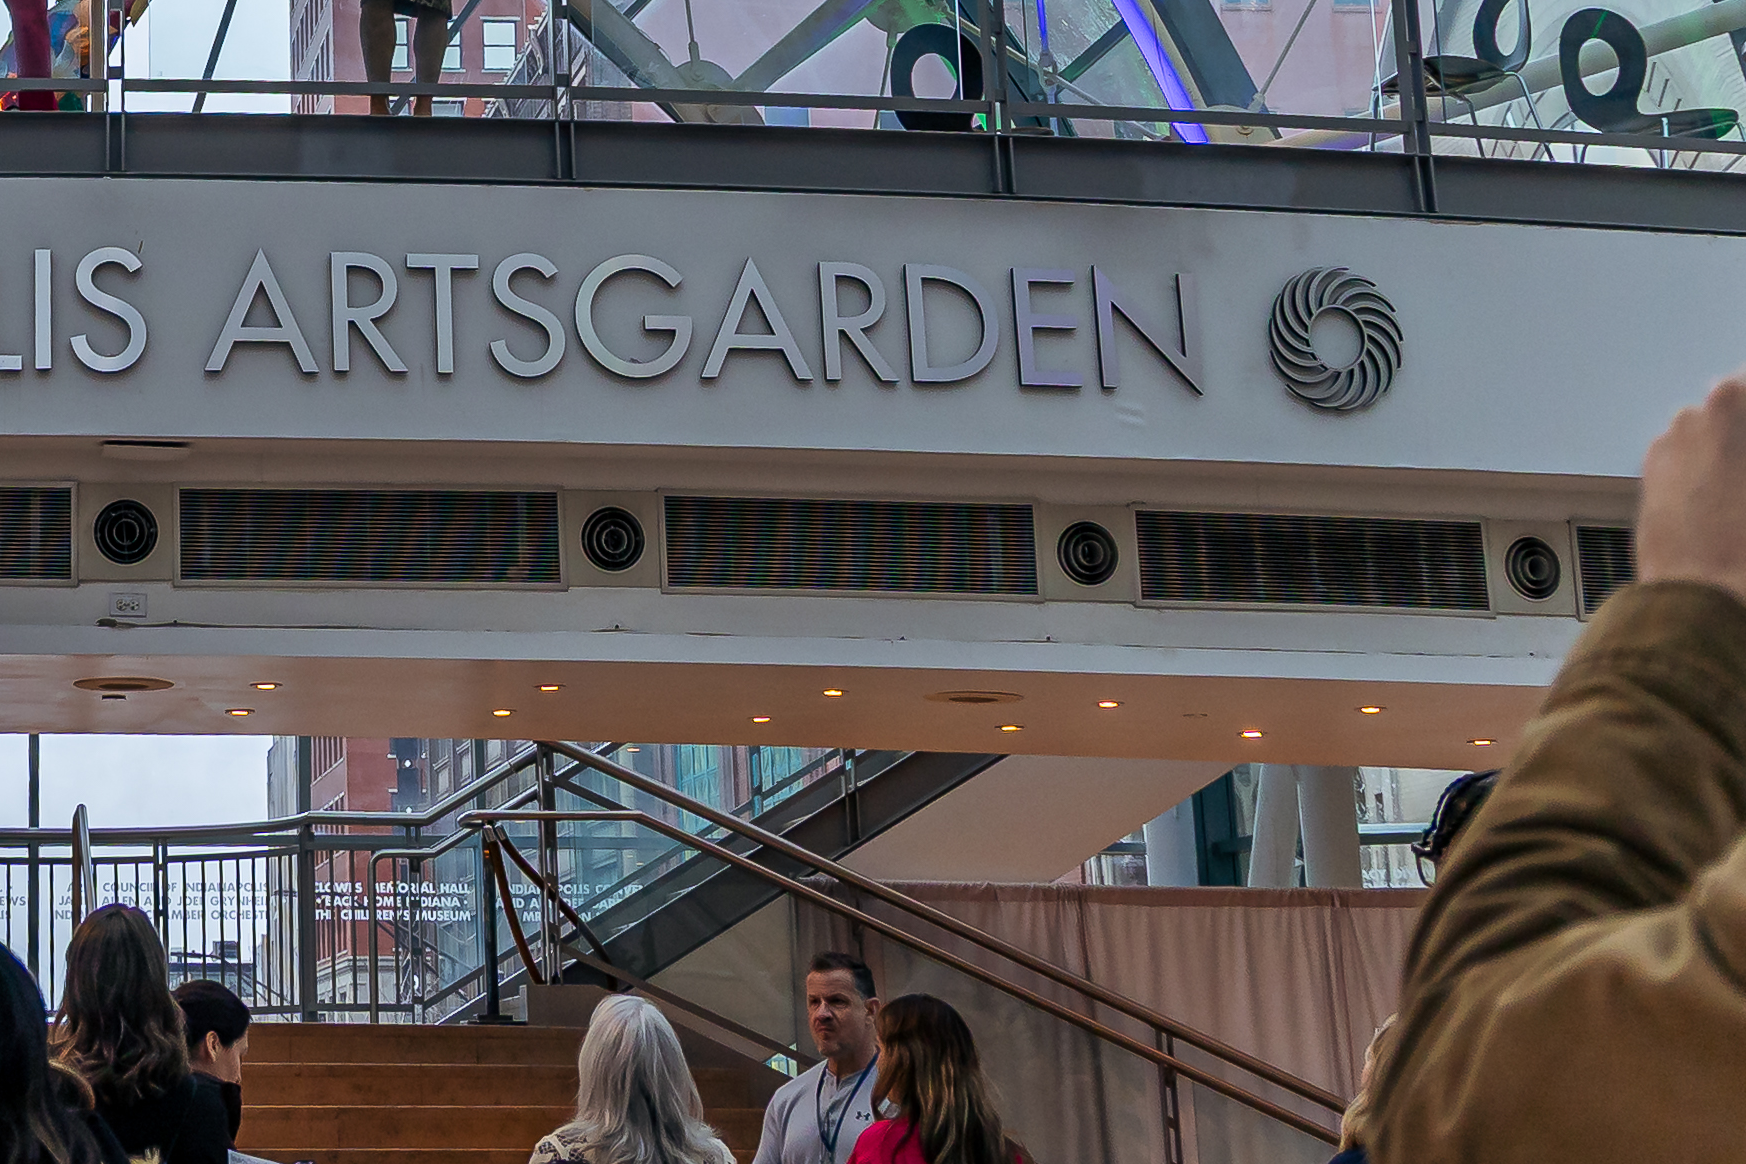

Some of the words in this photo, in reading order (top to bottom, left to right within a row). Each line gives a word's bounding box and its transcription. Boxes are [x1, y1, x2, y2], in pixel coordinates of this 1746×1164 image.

[204, 247, 1204, 397] ARTSGARDEN
[440, 883, 470, 894] HALL
[405, 896, 461, 907] IDIANA
